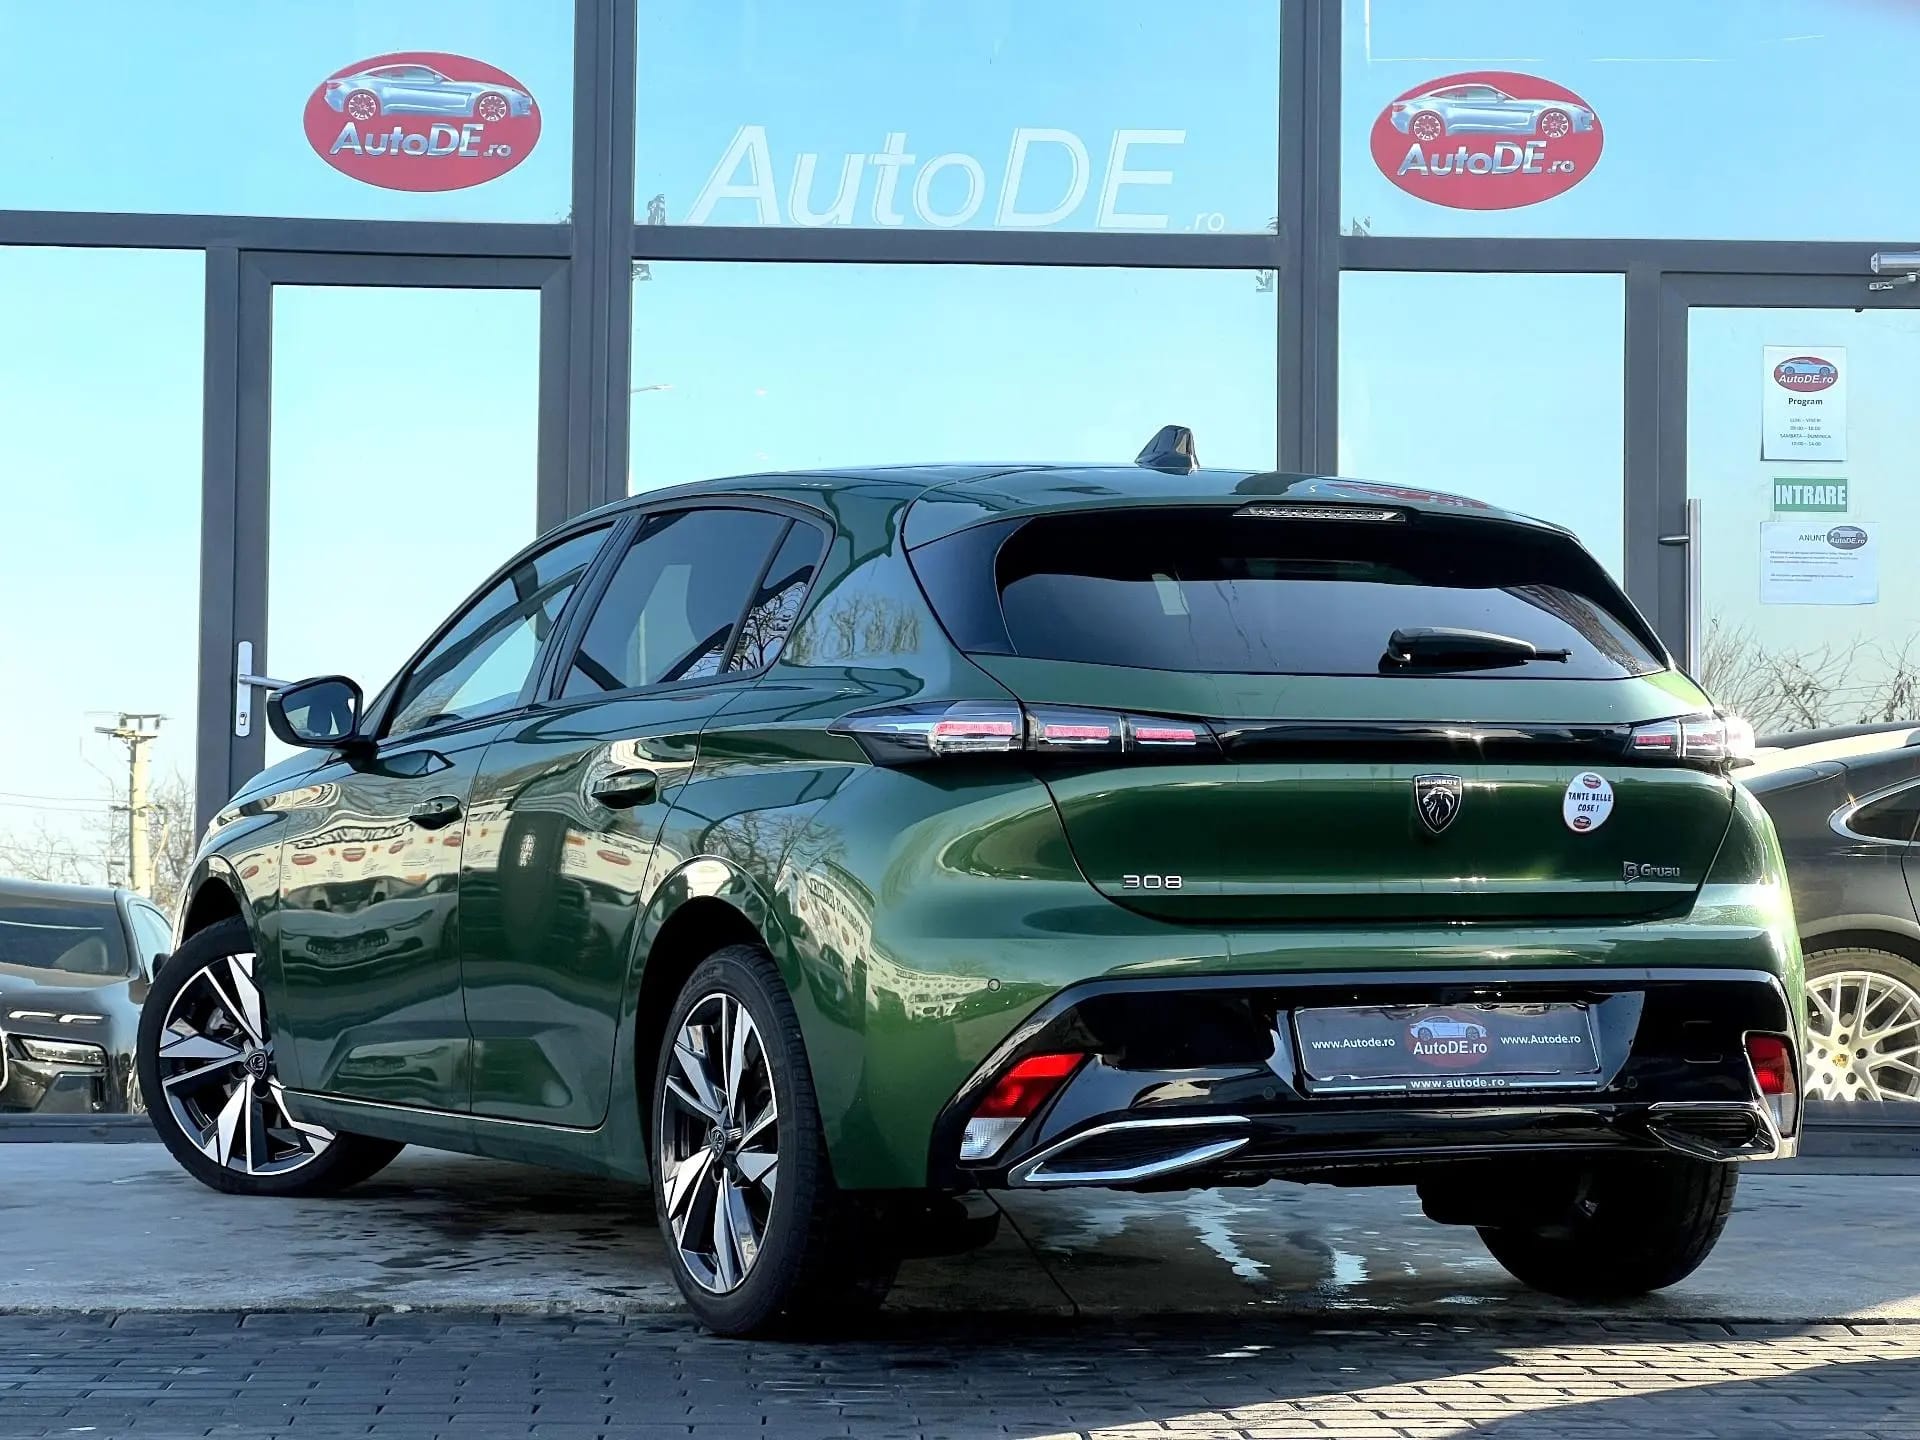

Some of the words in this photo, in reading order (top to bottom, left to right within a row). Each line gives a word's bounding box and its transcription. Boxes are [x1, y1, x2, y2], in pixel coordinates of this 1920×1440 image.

[1778, 374, 1834, 384] AutoDE.ro
[1788, 397, 1823, 407] Program
[1775, 484, 1846, 505] INTRARE
[1568, 791, 1590, 801] TANTE
[1591, 793, 1612, 802] BELLE
[1640, 863, 1680, 877] Gruau
[1123, 874, 1182, 889] 308
[1311, 1037, 1396, 1049] www.Autode.ro
[1500, 1034, 1582, 1045] www.Autode.ro
[1413, 1040, 1488, 1055] AutoDE.ro
[1410, 1077, 1506, 1089] www.autode.ro
